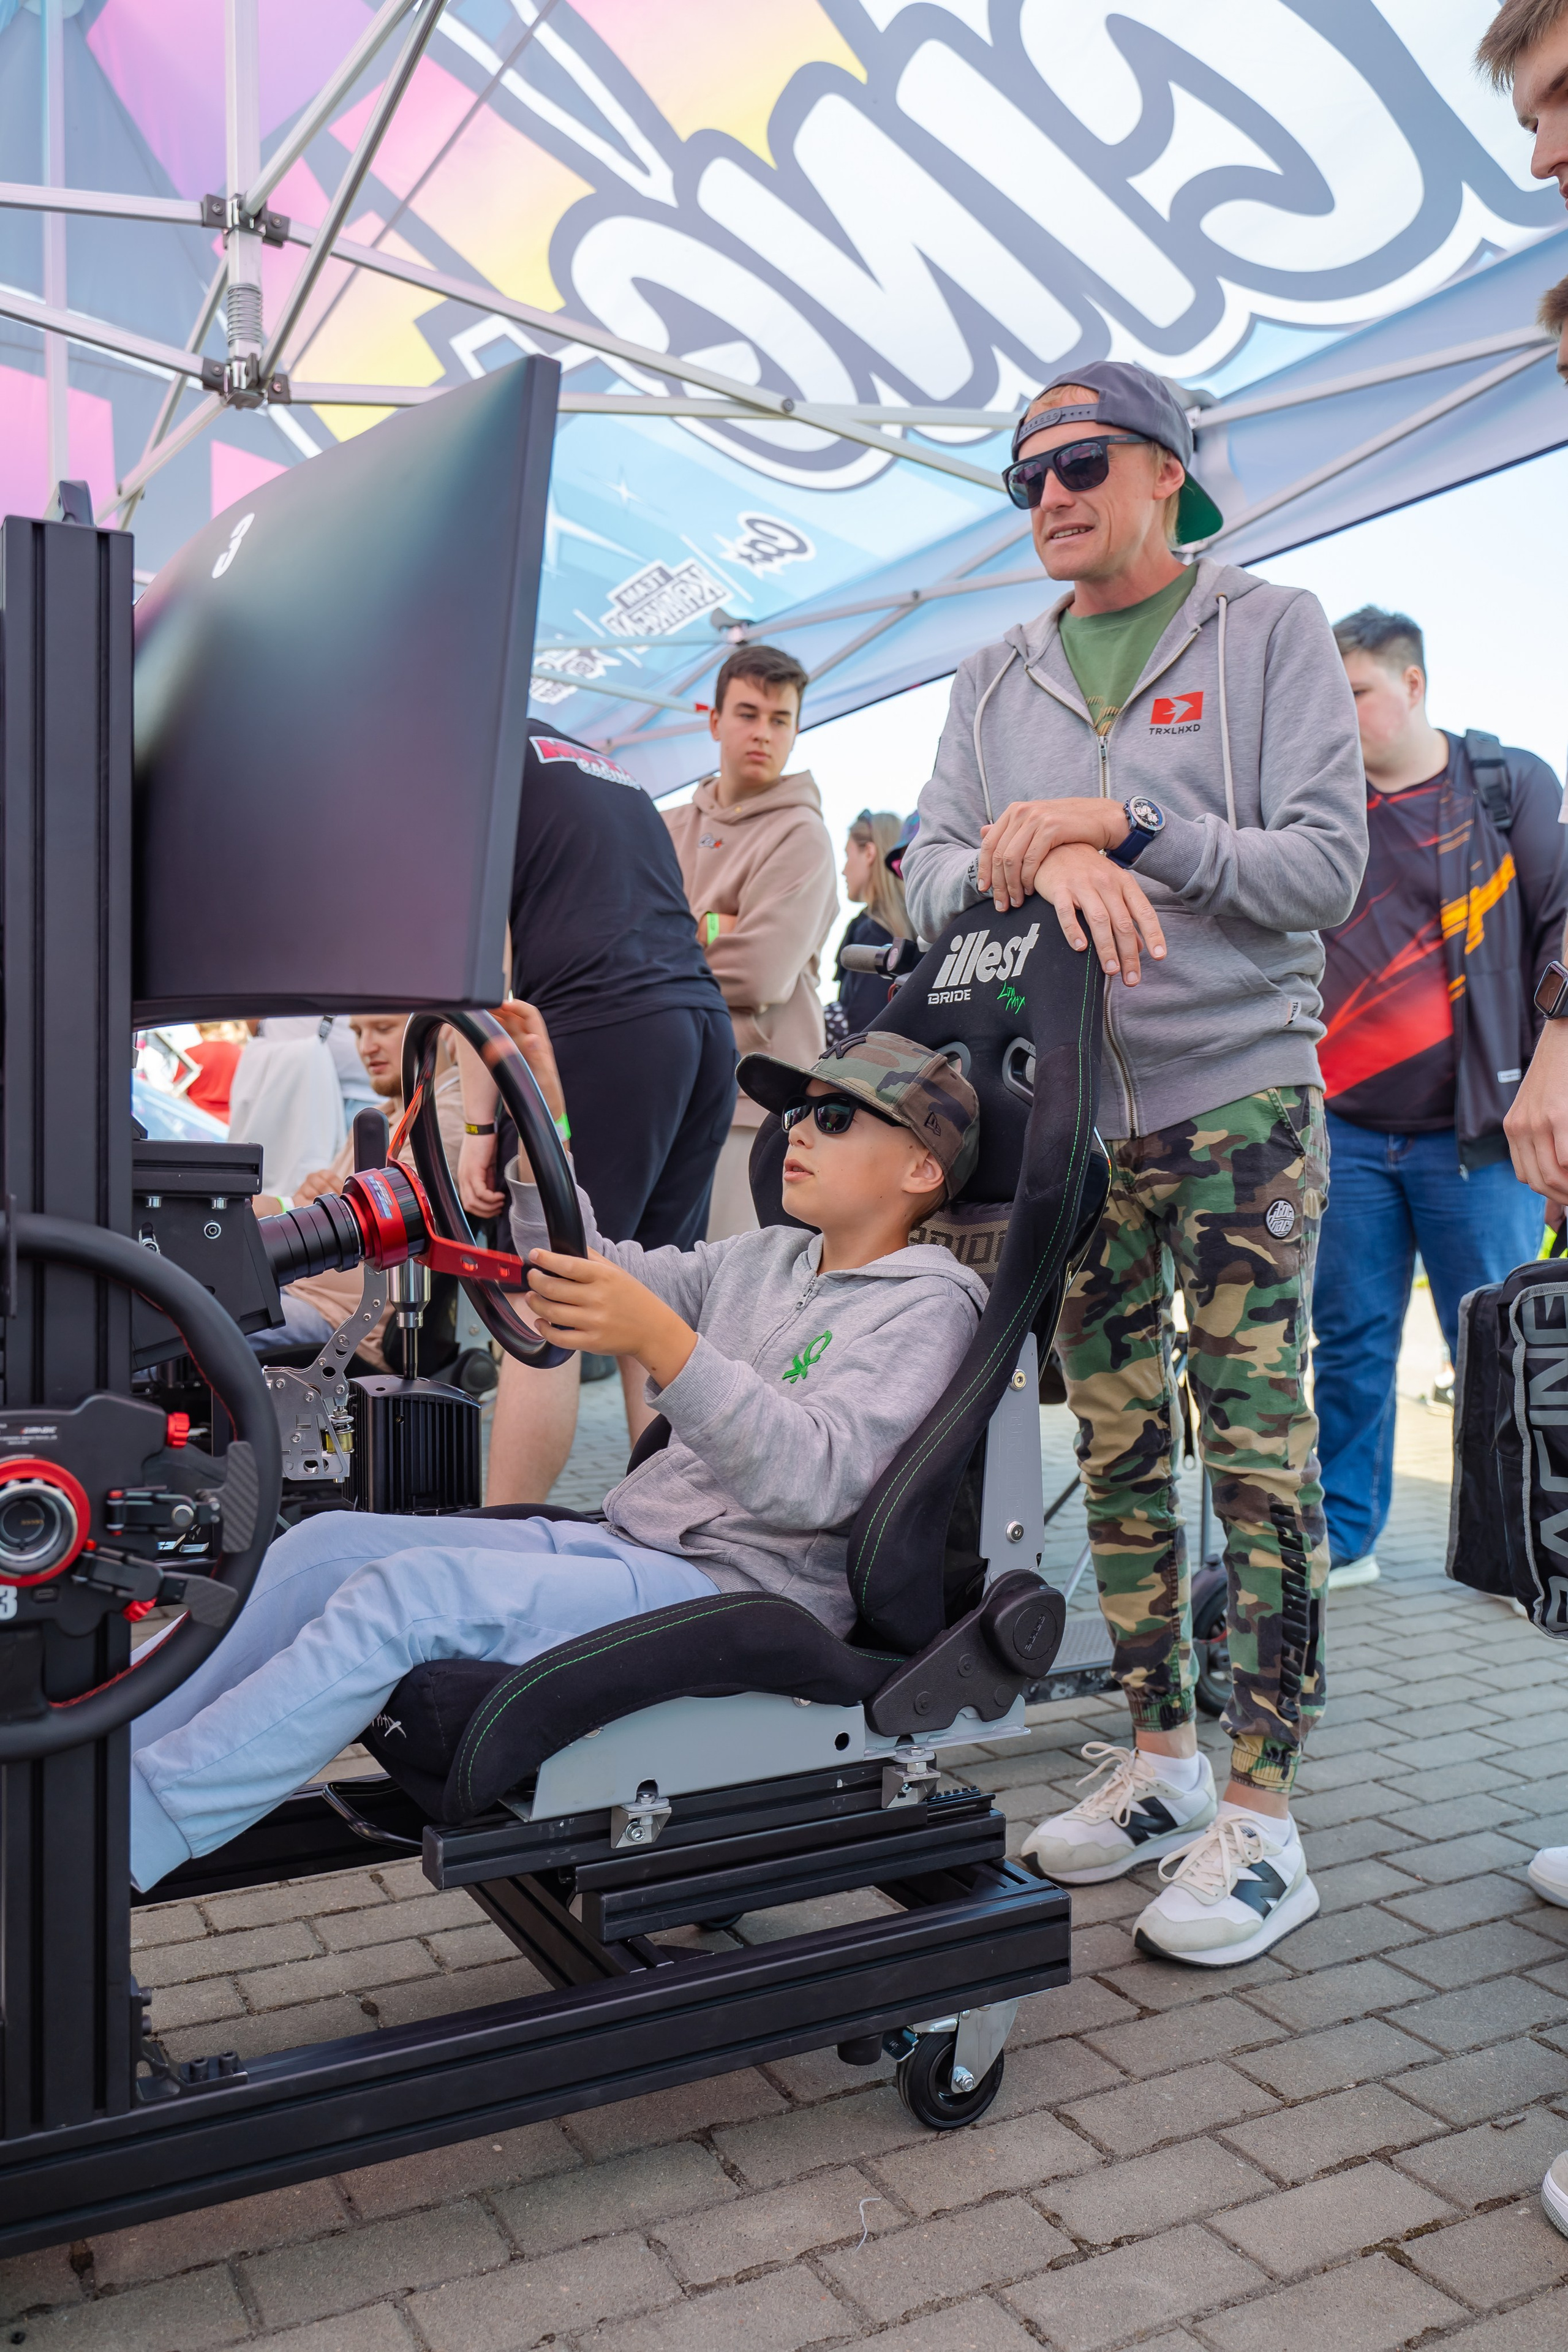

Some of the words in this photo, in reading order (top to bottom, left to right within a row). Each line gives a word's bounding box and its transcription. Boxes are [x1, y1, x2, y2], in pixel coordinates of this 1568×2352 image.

[1149, 723, 1200, 735] TRXLHXD
[932, 922, 1041, 989] illest
[927, 989, 971, 1005] BRIDE
